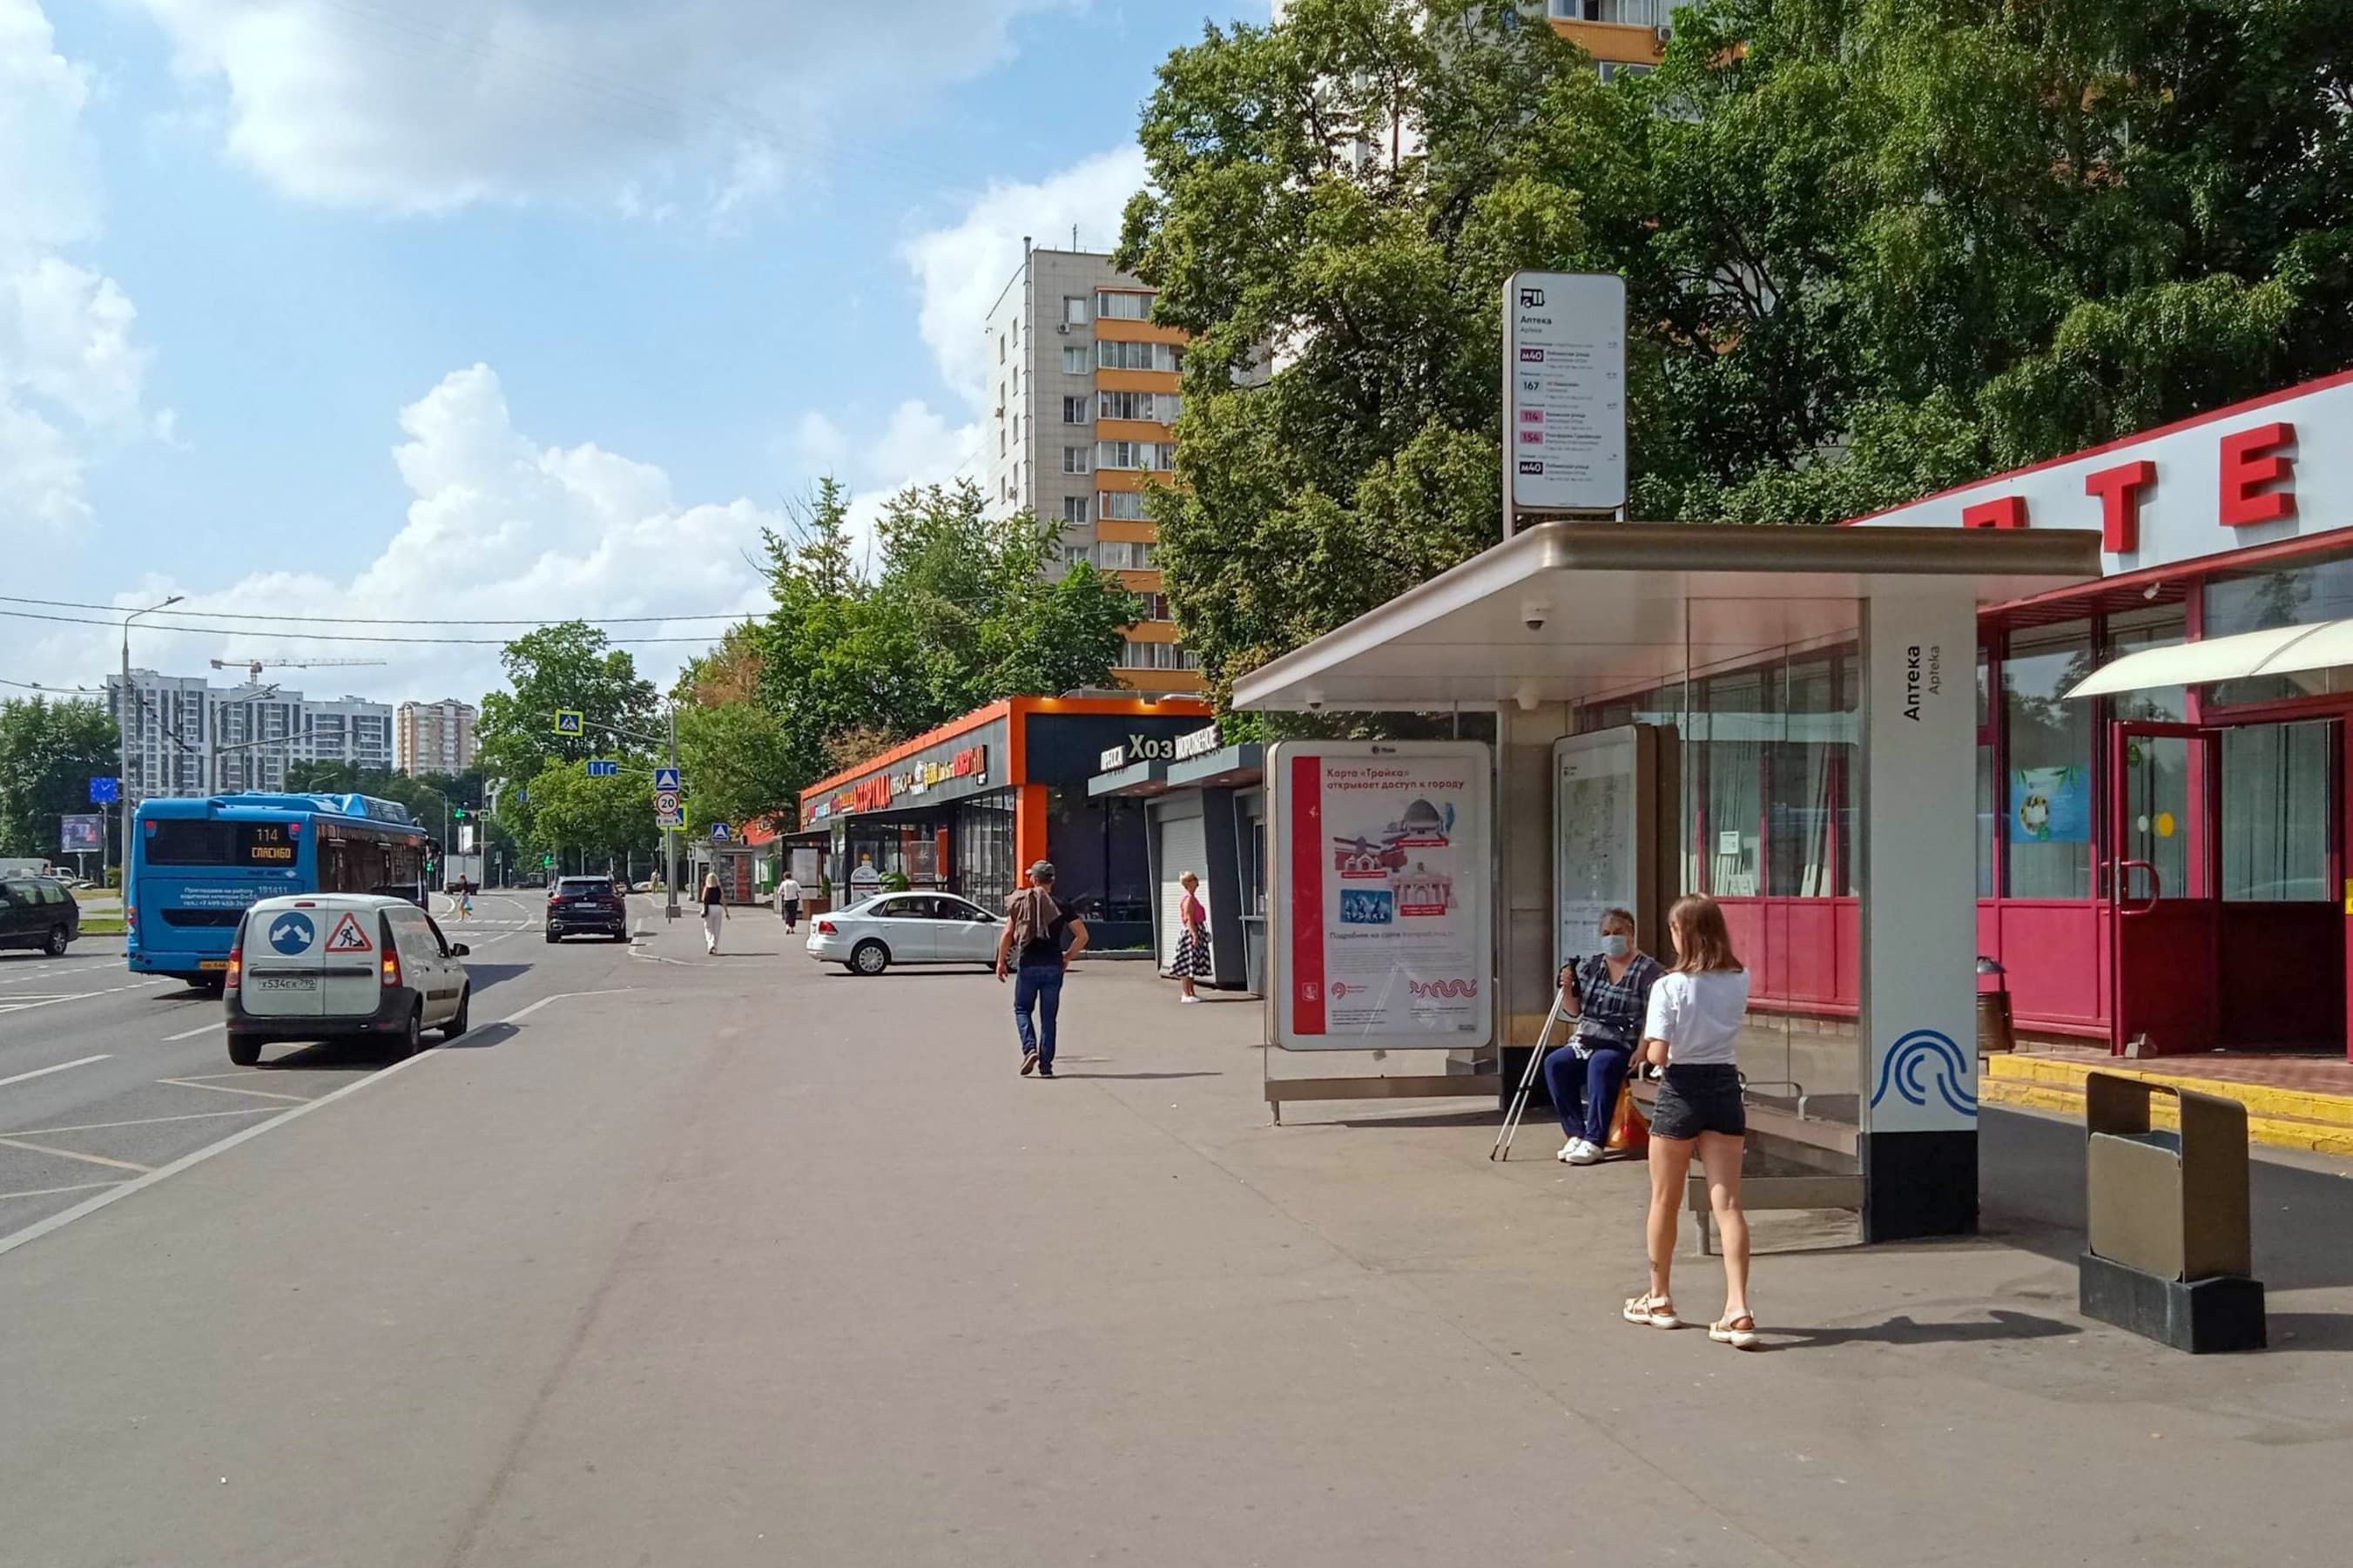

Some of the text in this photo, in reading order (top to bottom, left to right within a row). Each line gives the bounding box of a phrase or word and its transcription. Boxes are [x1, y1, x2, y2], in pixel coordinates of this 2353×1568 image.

[1520, 315, 1552, 325] Аптека
[1524, 381, 1540, 391] 167
[1525, 412, 1538, 421] 114
[1927, 645, 1942, 696] Apteka
[1903, 645, 1920, 722] Аптека
[1129, 734, 1182, 759] Хоз
[1327, 768, 1410, 779] Карта «Тройка»
[1327, 782, 1379, 791] открывает
[1381, 781, 1417, 791] доступ
[1428, 781, 1465, 790] городу
[662, 798, 675, 808] 20
[256, 829, 278, 841] 114
[251, 847, 291, 858] СПАСИБО
